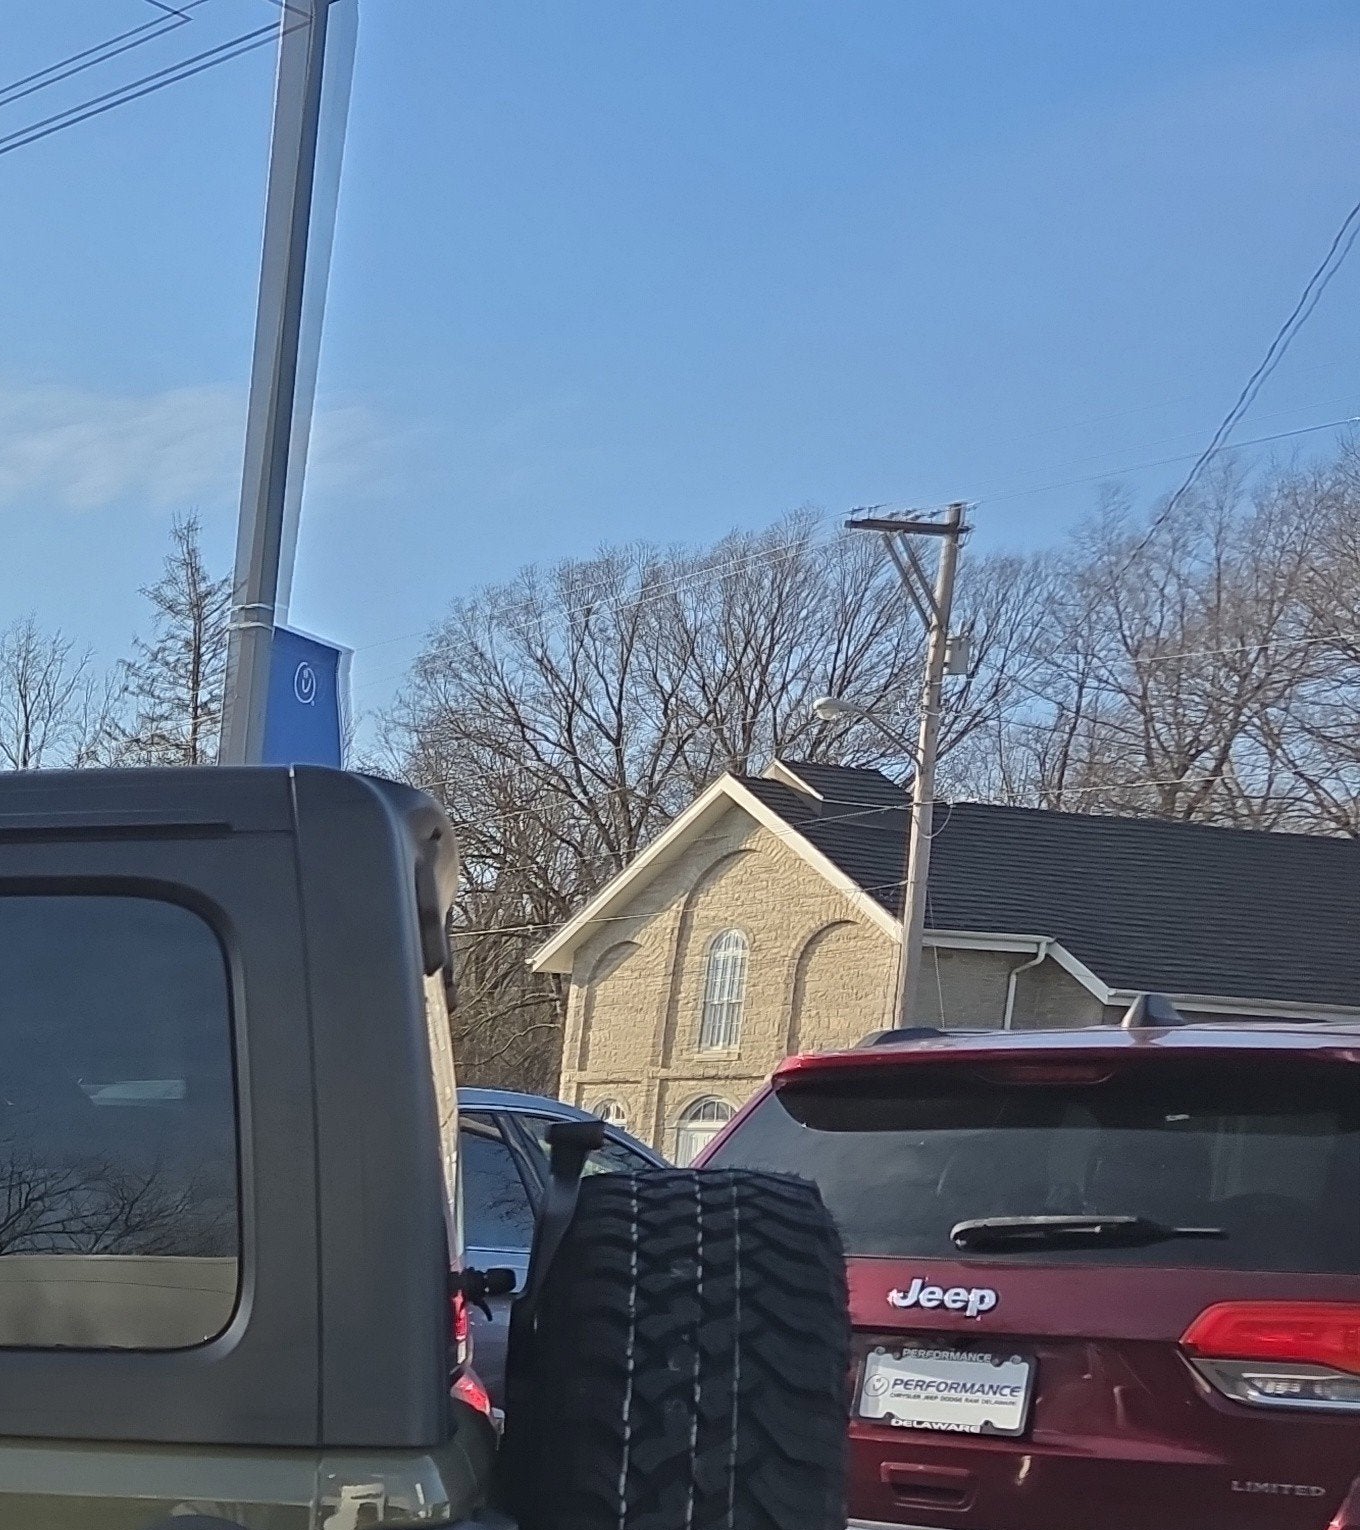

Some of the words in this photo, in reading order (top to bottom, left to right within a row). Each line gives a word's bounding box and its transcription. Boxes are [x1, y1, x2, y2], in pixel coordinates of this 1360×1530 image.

[887, 1277, 998, 1318] Jeep
[902, 1348, 992, 1363] PERFORMANCE
[892, 1378, 1022, 1397] PERFORMANCE
[890, 1418, 981, 1434] DELAWARE
[1230, 1480, 1327, 1497] LIMITED
